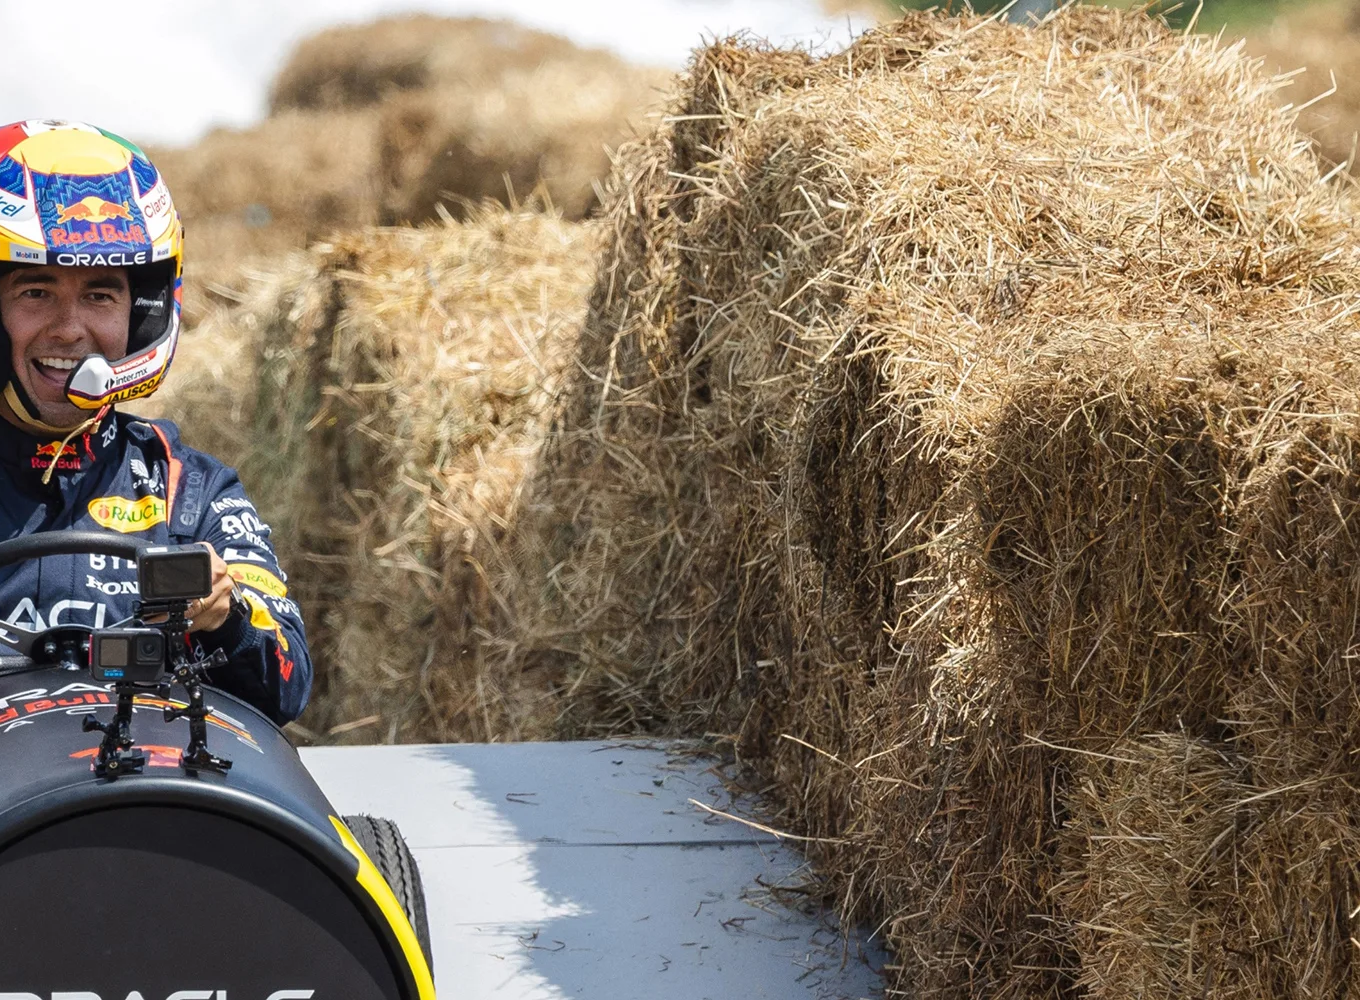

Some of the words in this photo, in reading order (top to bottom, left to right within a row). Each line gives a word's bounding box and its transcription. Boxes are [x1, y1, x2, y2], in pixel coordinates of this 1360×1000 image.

[144, 194, 166, 218] Claro
[50, 223, 99, 246] Red
[101, 223, 145, 244] Bull
[56, 251, 147, 266] ORACLE
[116, 367, 148, 386] inter.mx
[57, 458, 81, 469] Bull
[112, 503, 164, 523] RAUCH
[86, 575, 139, 595] HON
[26, 693, 110, 714] Bull
